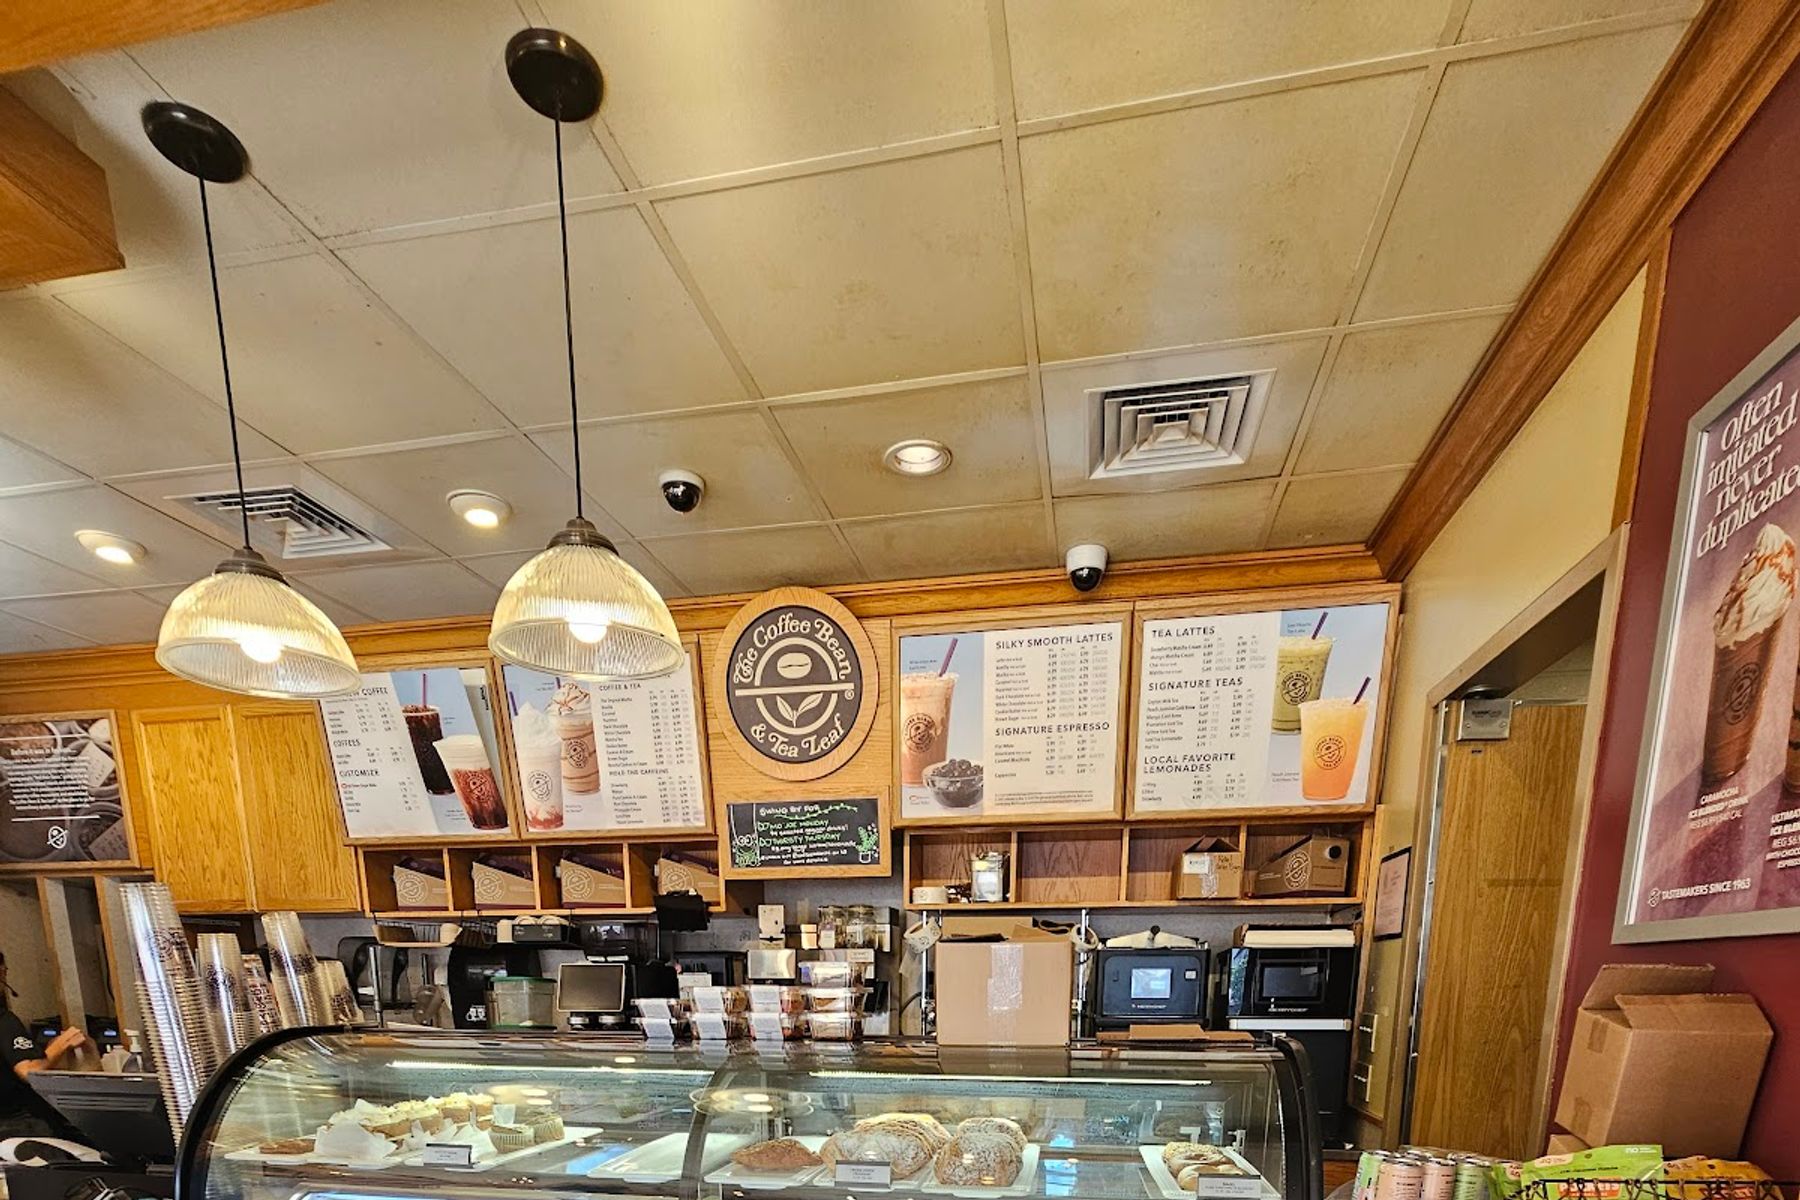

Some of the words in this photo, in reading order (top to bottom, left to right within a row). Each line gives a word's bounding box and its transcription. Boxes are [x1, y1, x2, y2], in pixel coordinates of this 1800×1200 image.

[1720, 381, 1784, 451] Often
[1714, 444, 1782, 517] never
[1151, 628, 1174, 638] TEA
[1176, 625, 1215, 638] LATTES
[733, 646, 758, 684] The
[753, 612, 812, 648] Coffee
[814, 618, 852, 680] Bean
[995, 639, 1025, 650] SILKY
[1027, 636, 1073, 648] SMOOTH
[1076, 632, 1113, 643] LATTES
[1147, 679, 1213, 692] SIGNATURE
[1215, 676, 1244, 688] TEAS
[751, 723, 765, 743] &
[768, 732, 799, 758] Tea
[801, 713, 845, 756] Leaf
[995, 724, 1053, 736] SIGNATURE
[1056, 721, 1110, 733] ESPRESSO
[1144, 755, 1179, 765] LOCAL
[1182, 752, 1236, 763] FAVORITE
[1143, 763, 1212, 774] LEMONADES
[1709, 880, 1732, 894] SINCE
